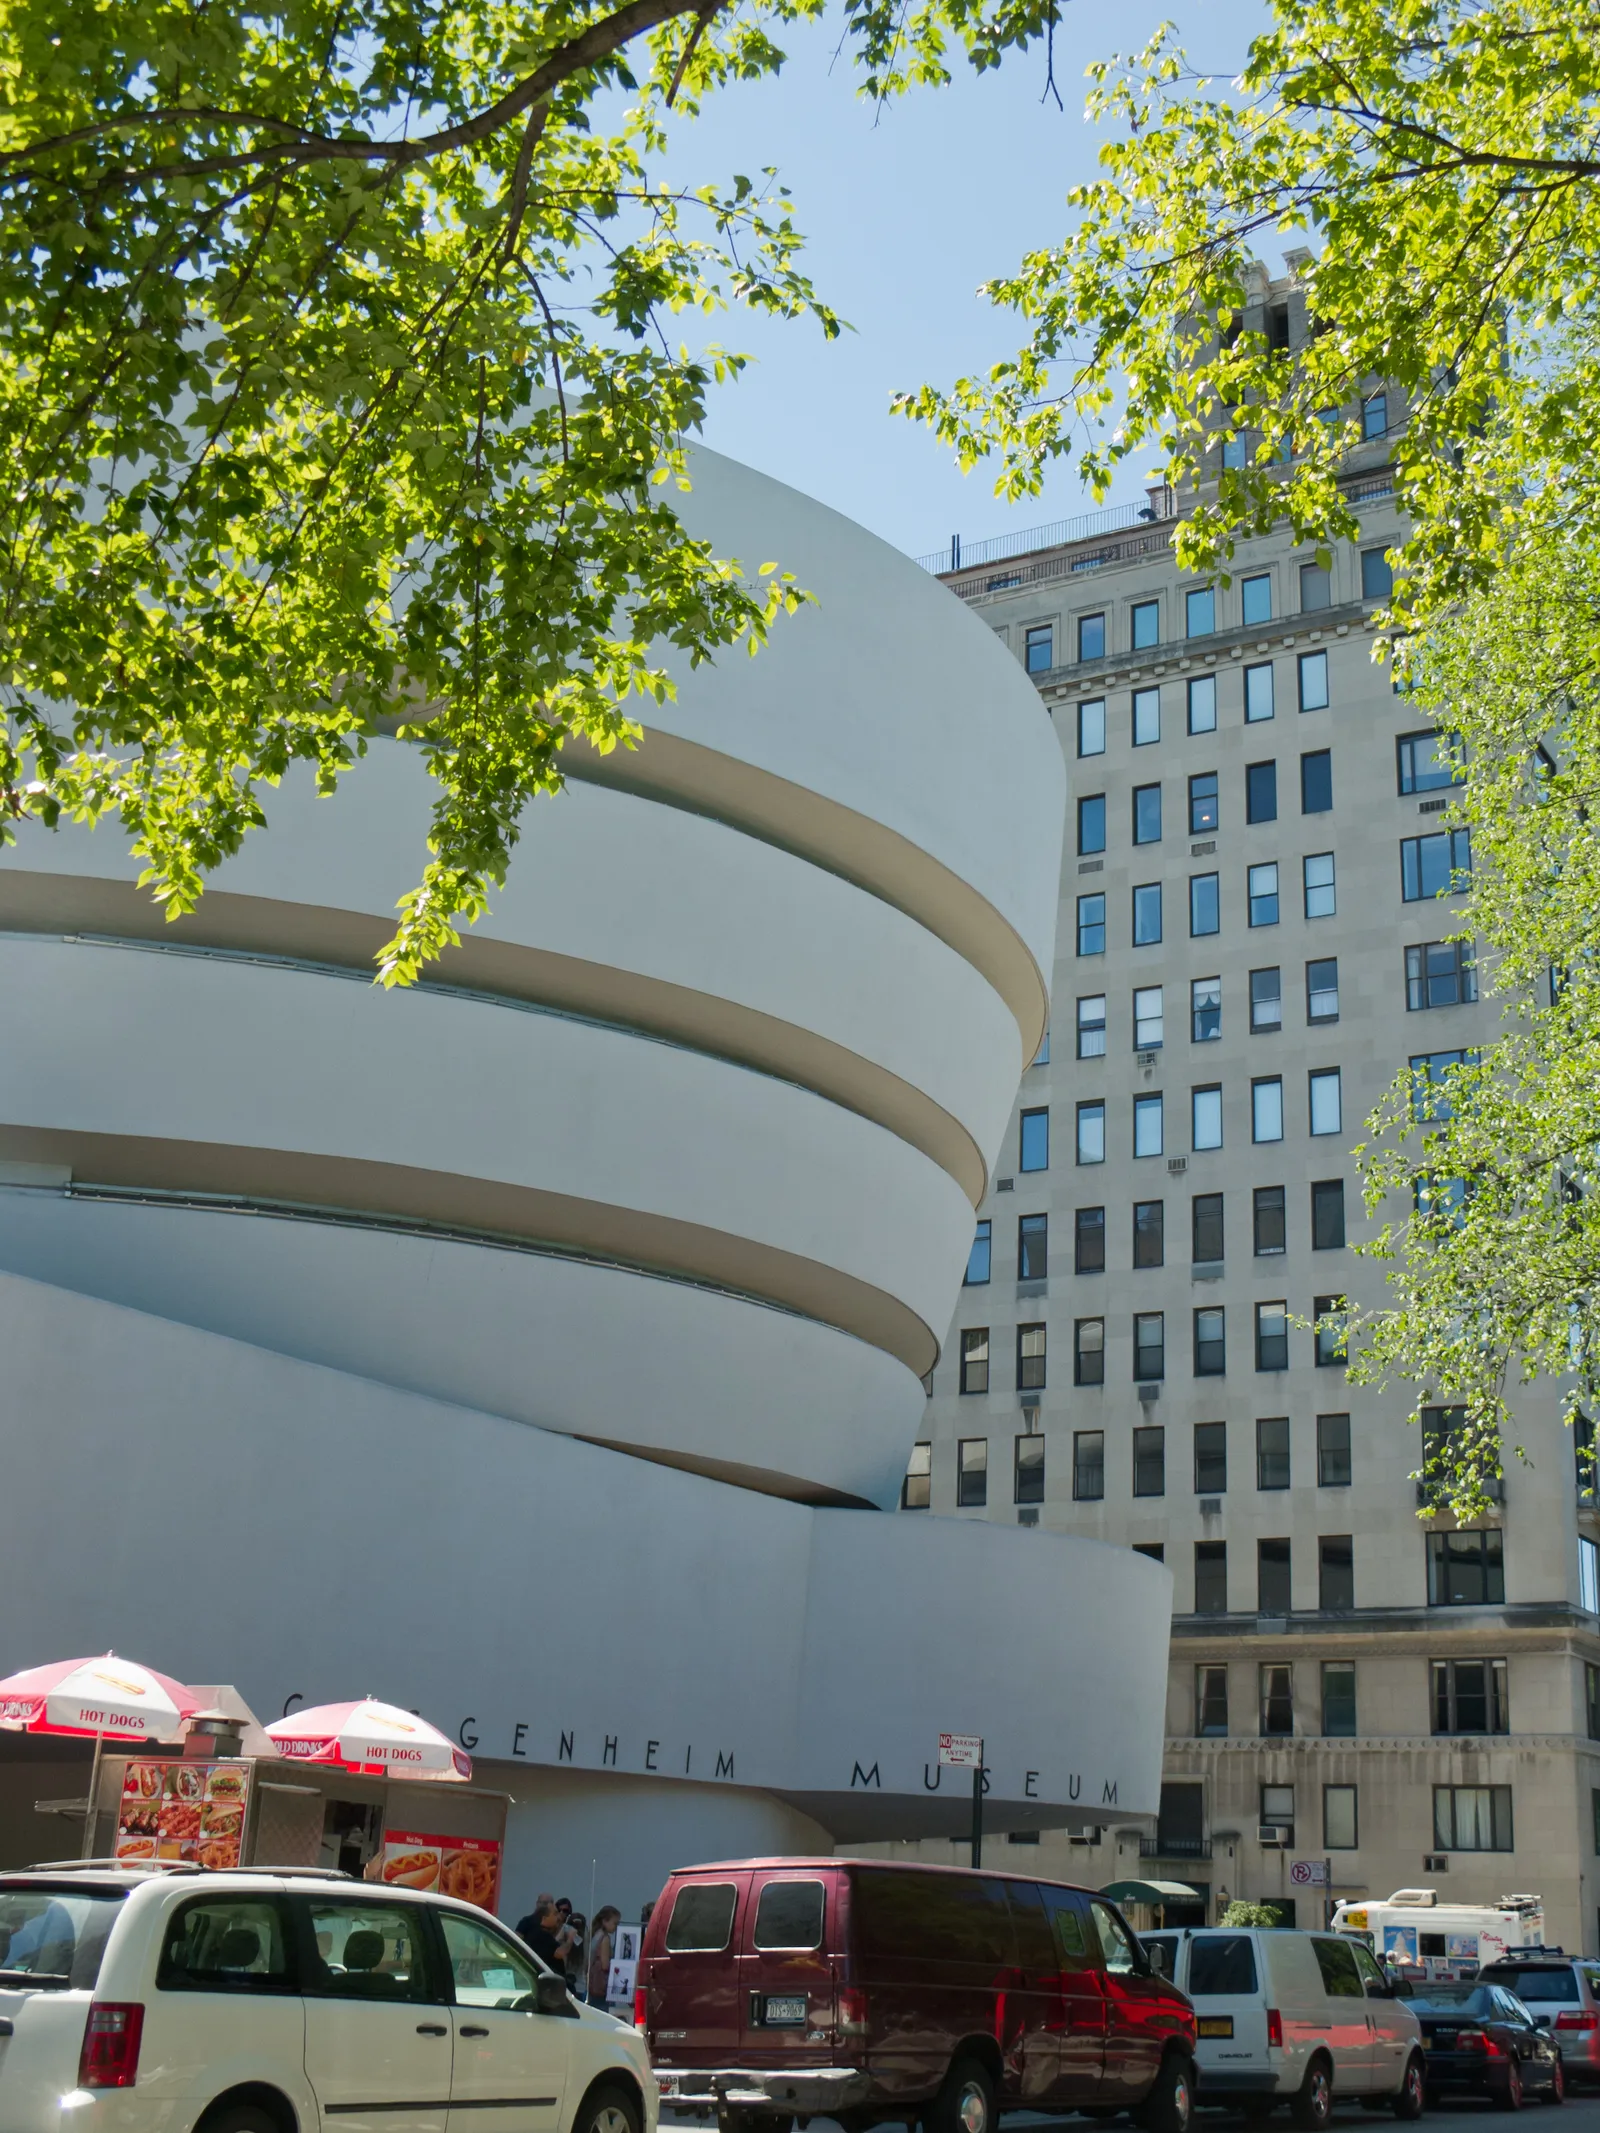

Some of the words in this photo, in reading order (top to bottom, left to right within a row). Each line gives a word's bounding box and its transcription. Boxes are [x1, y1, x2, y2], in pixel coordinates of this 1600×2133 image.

[79, 1709, 106, 1723] HOT
[109, 1713, 145, 1729] DOGS
[274, 1740, 291, 1752] OLD
[291, 1740, 324, 1755] DRINKS
[940, 1736, 951, 1747] NO
[951, 1739, 979, 1748] PARKING
[366, 1747, 389, 1758] HOT
[391, 1748, 422, 1761] DOGS
[945, 1749, 973, 1758] ANYTIME
[850, 1761, 1118, 1804] MUSEUM
